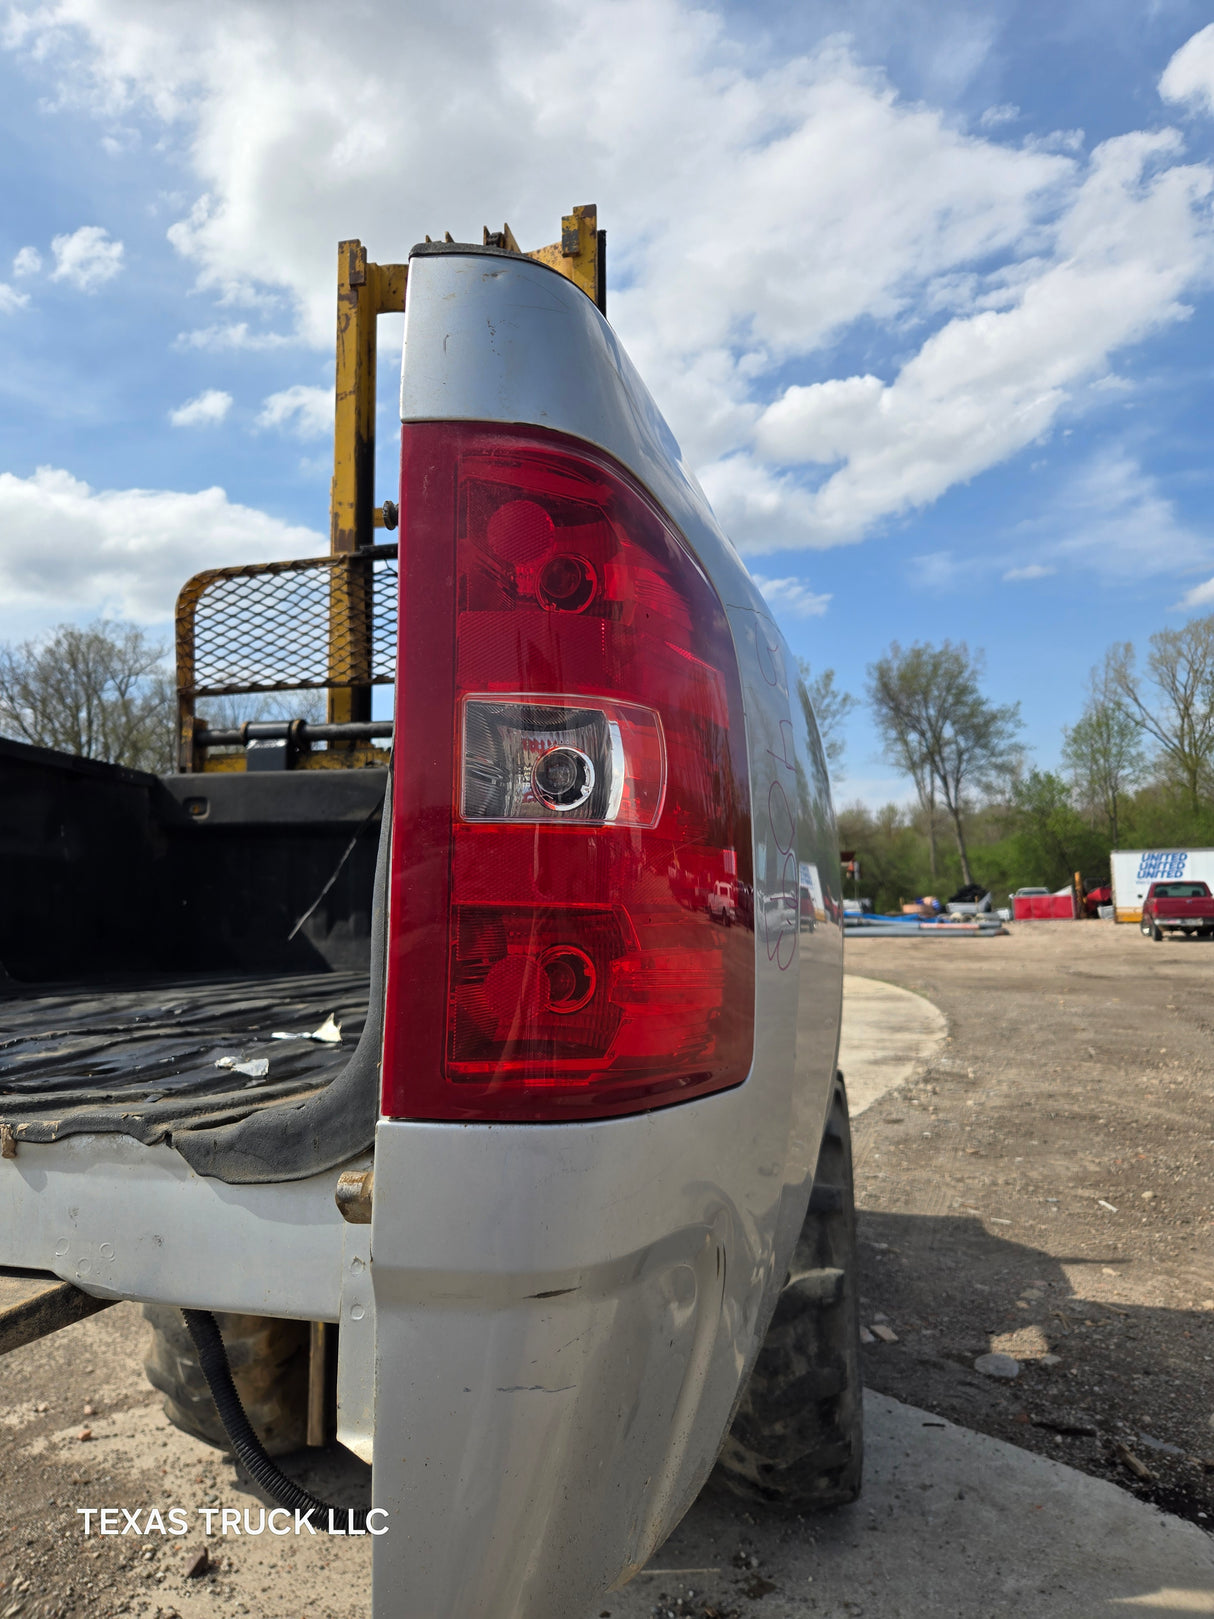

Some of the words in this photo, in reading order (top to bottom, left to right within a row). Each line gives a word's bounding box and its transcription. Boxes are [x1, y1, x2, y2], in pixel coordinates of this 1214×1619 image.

[1142, 852, 1188, 862] UNITED
[1140, 862, 1185, 870] UNITED
[1137, 870, 1183, 878] UNITED
